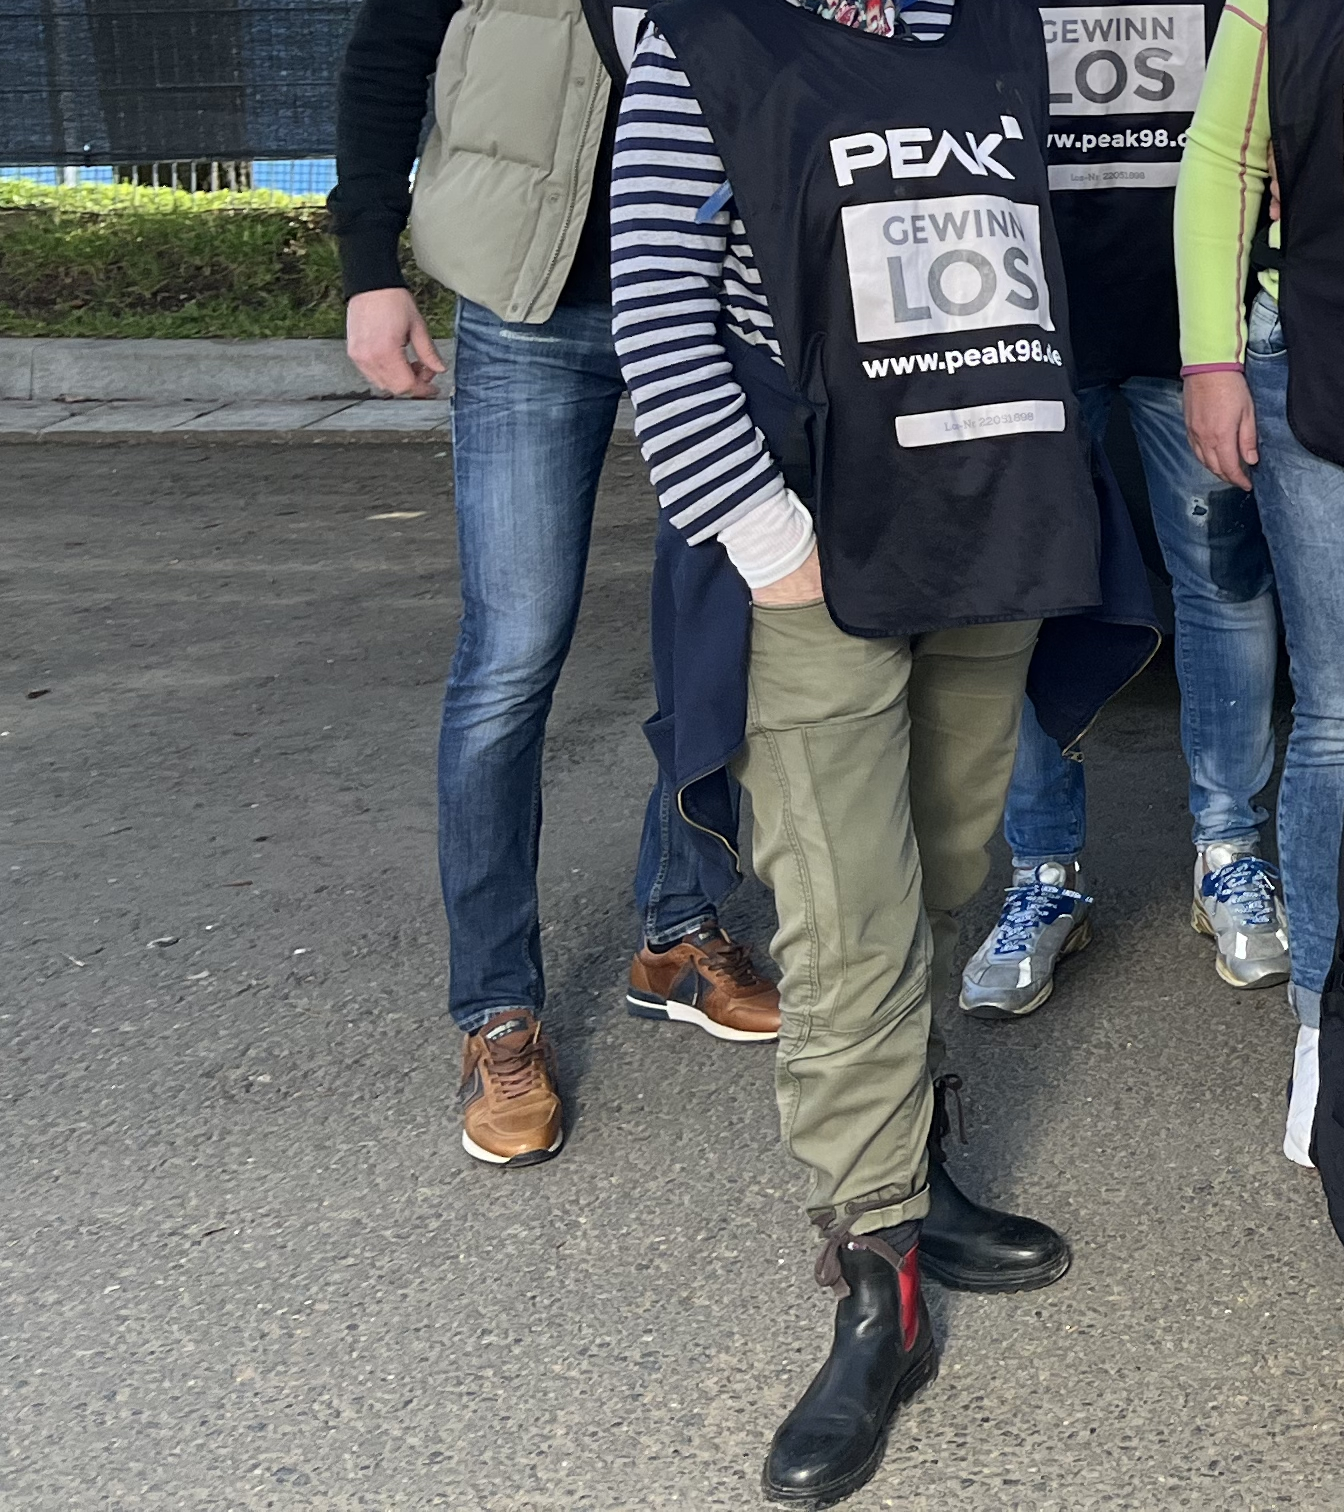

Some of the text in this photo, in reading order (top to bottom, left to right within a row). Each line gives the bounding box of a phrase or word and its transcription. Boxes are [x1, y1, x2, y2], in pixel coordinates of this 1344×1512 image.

[1043, 17, 1175, 44] GEWINN
[829, 128, 1017, 187] PEAK
[882, 208, 1027, 246] GEWINN
[886, 246, 1040, 325] LOS
[862, 339, 1063, 379] www.peak98.de
